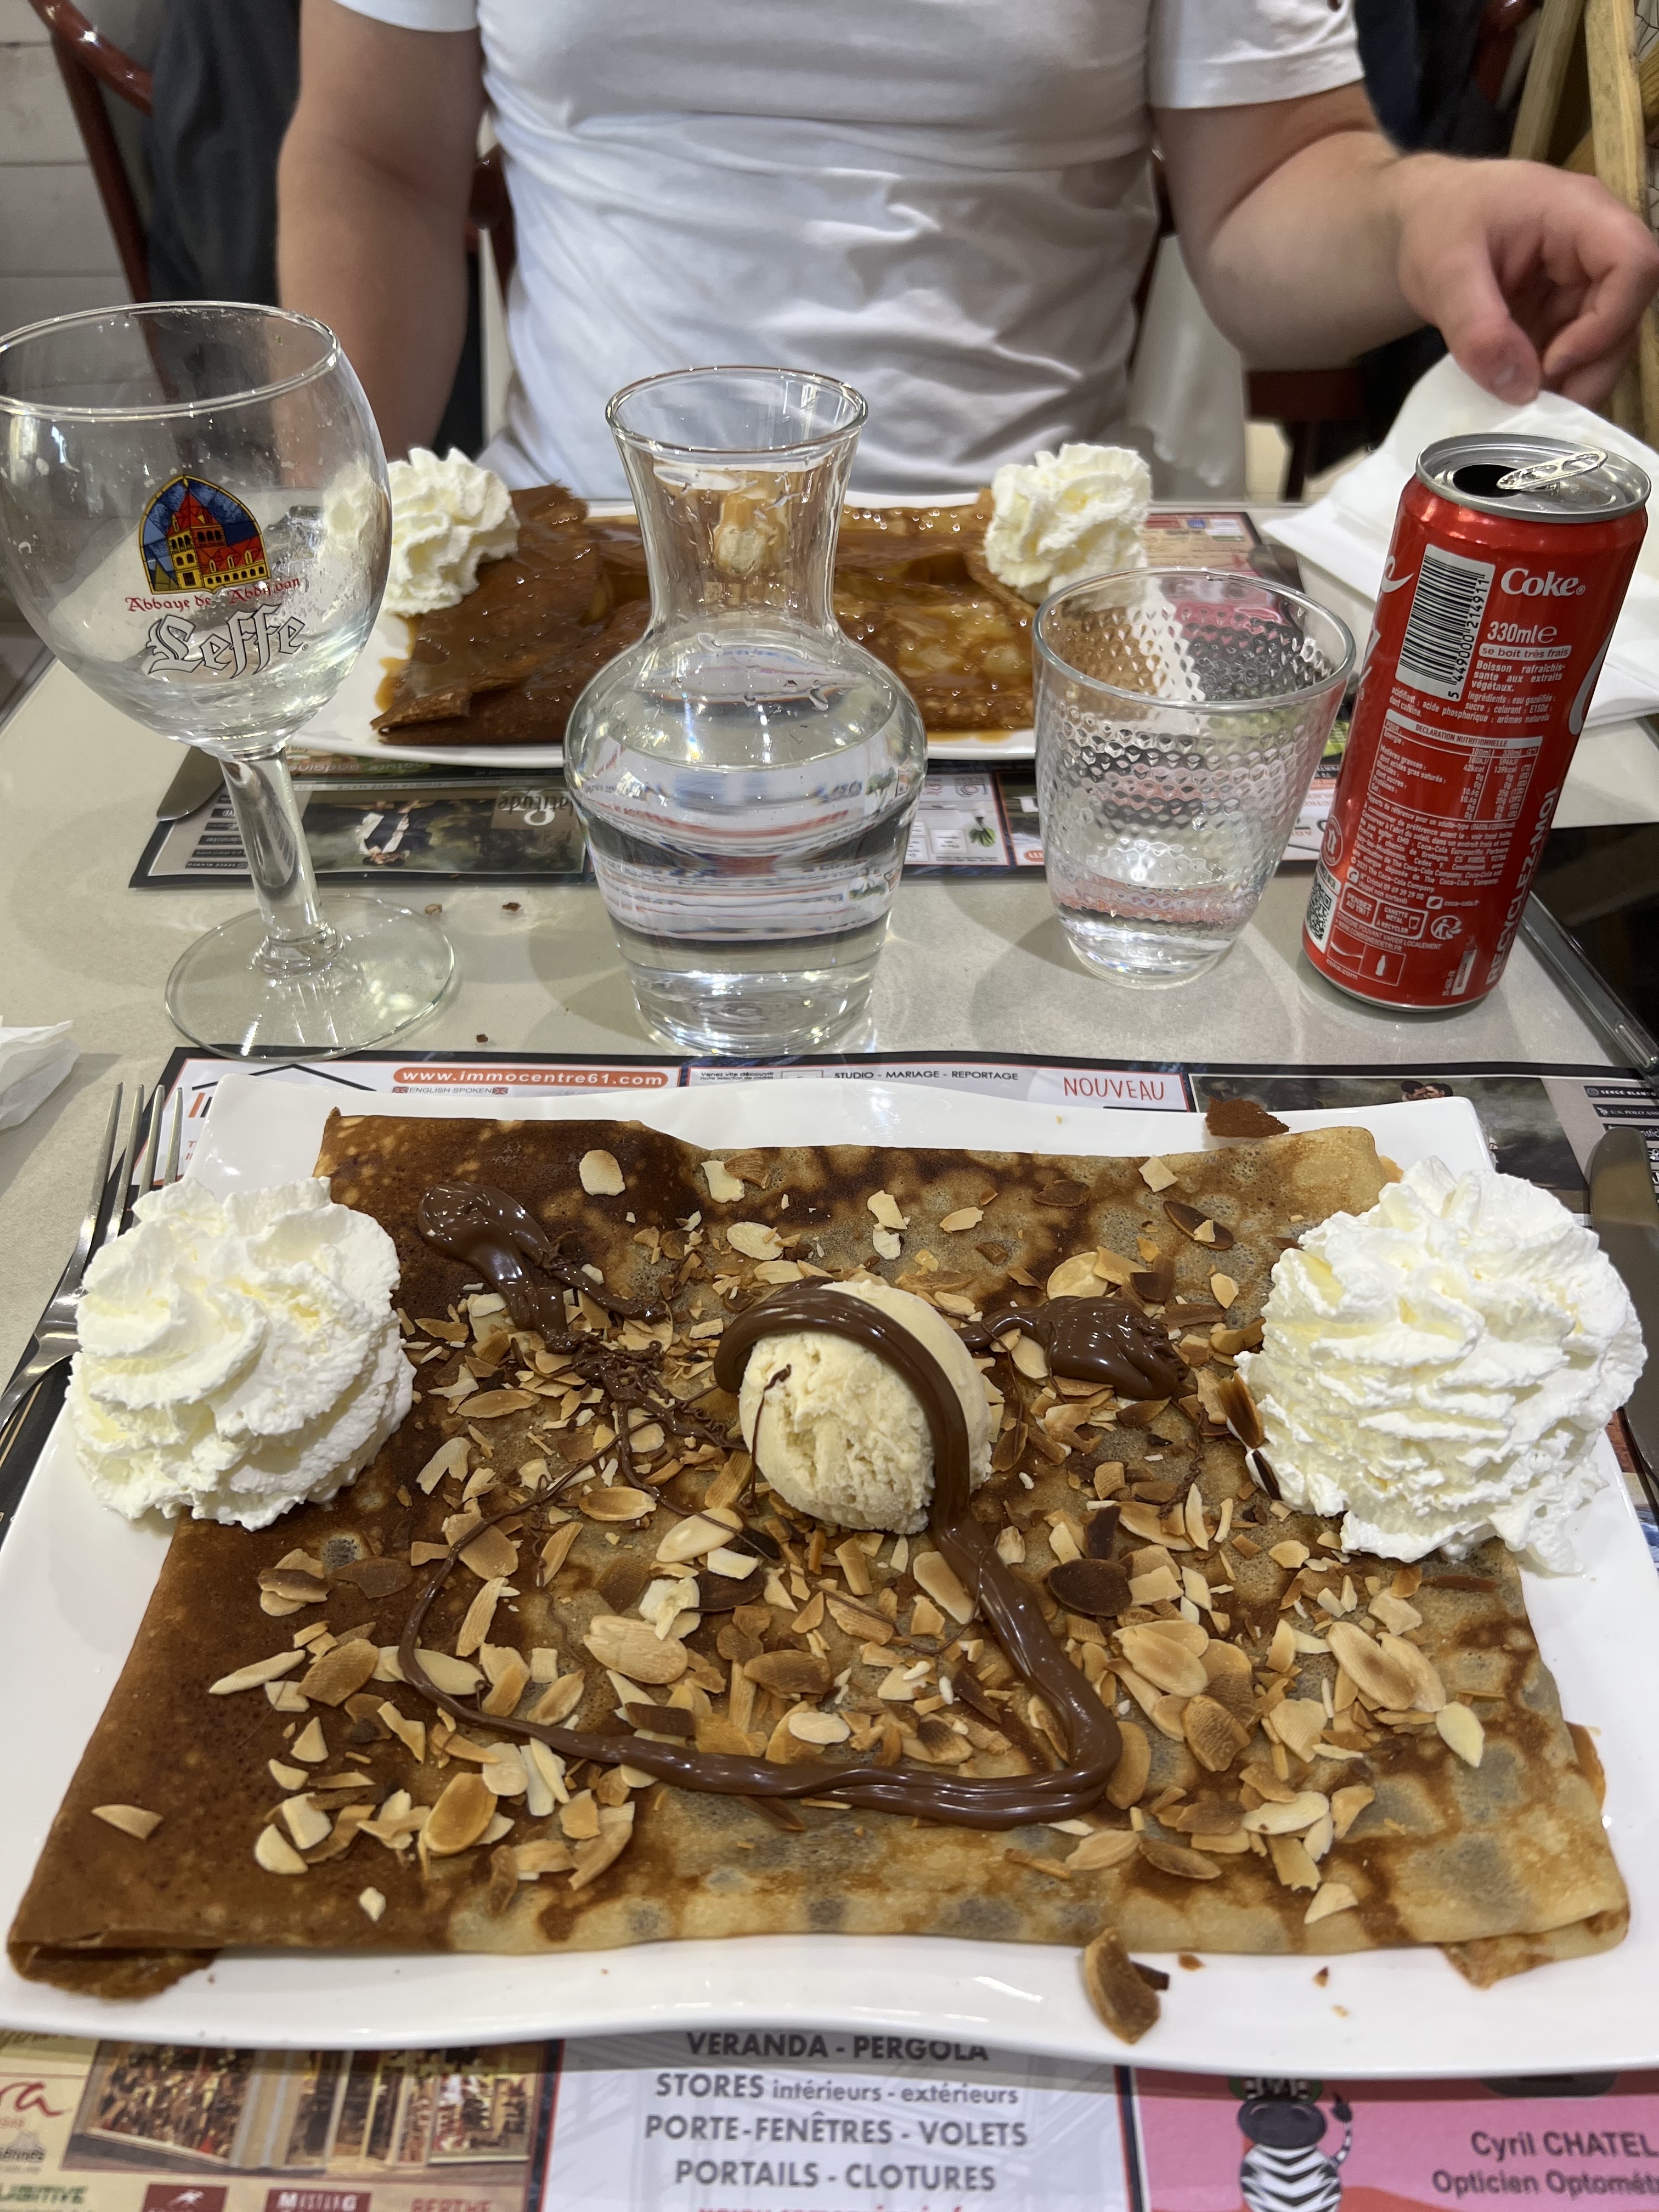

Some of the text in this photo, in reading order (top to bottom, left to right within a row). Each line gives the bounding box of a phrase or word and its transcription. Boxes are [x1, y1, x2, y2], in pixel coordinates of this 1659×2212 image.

[274, 578, 300, 591] van
[1500, 567, 1579, 597] Coke
[126, 595, 211, 613] Abbaye de
[146, 603, 306, 680] Leffe
[1453, 634, 1475, 682] 449000
[1466, 580, 1490, 629] 214911
[1498, 648, 1521, 658] boit
[1547, 648, 1568, 658] frais
[1476, 660, 1512, 673] Boisson
[1506, 675, 1523, 683] aux
[1531, 672, 1562, 683] extraits
[1422, 701, 1440, 712] acide
[1465, 702, 1485, 712] sucre
[1494, 706, 1521, 714] colorant
[1415, 724, 1508, 747] DECLARATION NUTRITIONNELLE
[402, 1069, 664, 1086] www.immocentre61.com
[834, 1071, 1019, 1080] STUDIO MARIAGE REPORTAGE
[409, 1086, 454, 1094] ENGLISH
[1063, 1077, 1165, 1102] NOUVEAU
[686, 2033, 989, 2062] VERANDA PERGOLA
[655, 2073, 1019, 2106] STORES intérieurs extérieurs
[645, 2111, 1028, 2148] PORTE-FENÊTRES VOLETS
[1471, 2131, 1659, 2162] Cyril CHATEL
[675, 2160, 996, 2192] PORTAILS CLOTURES
[1432, 2169, 1539, 2197] Opticien
